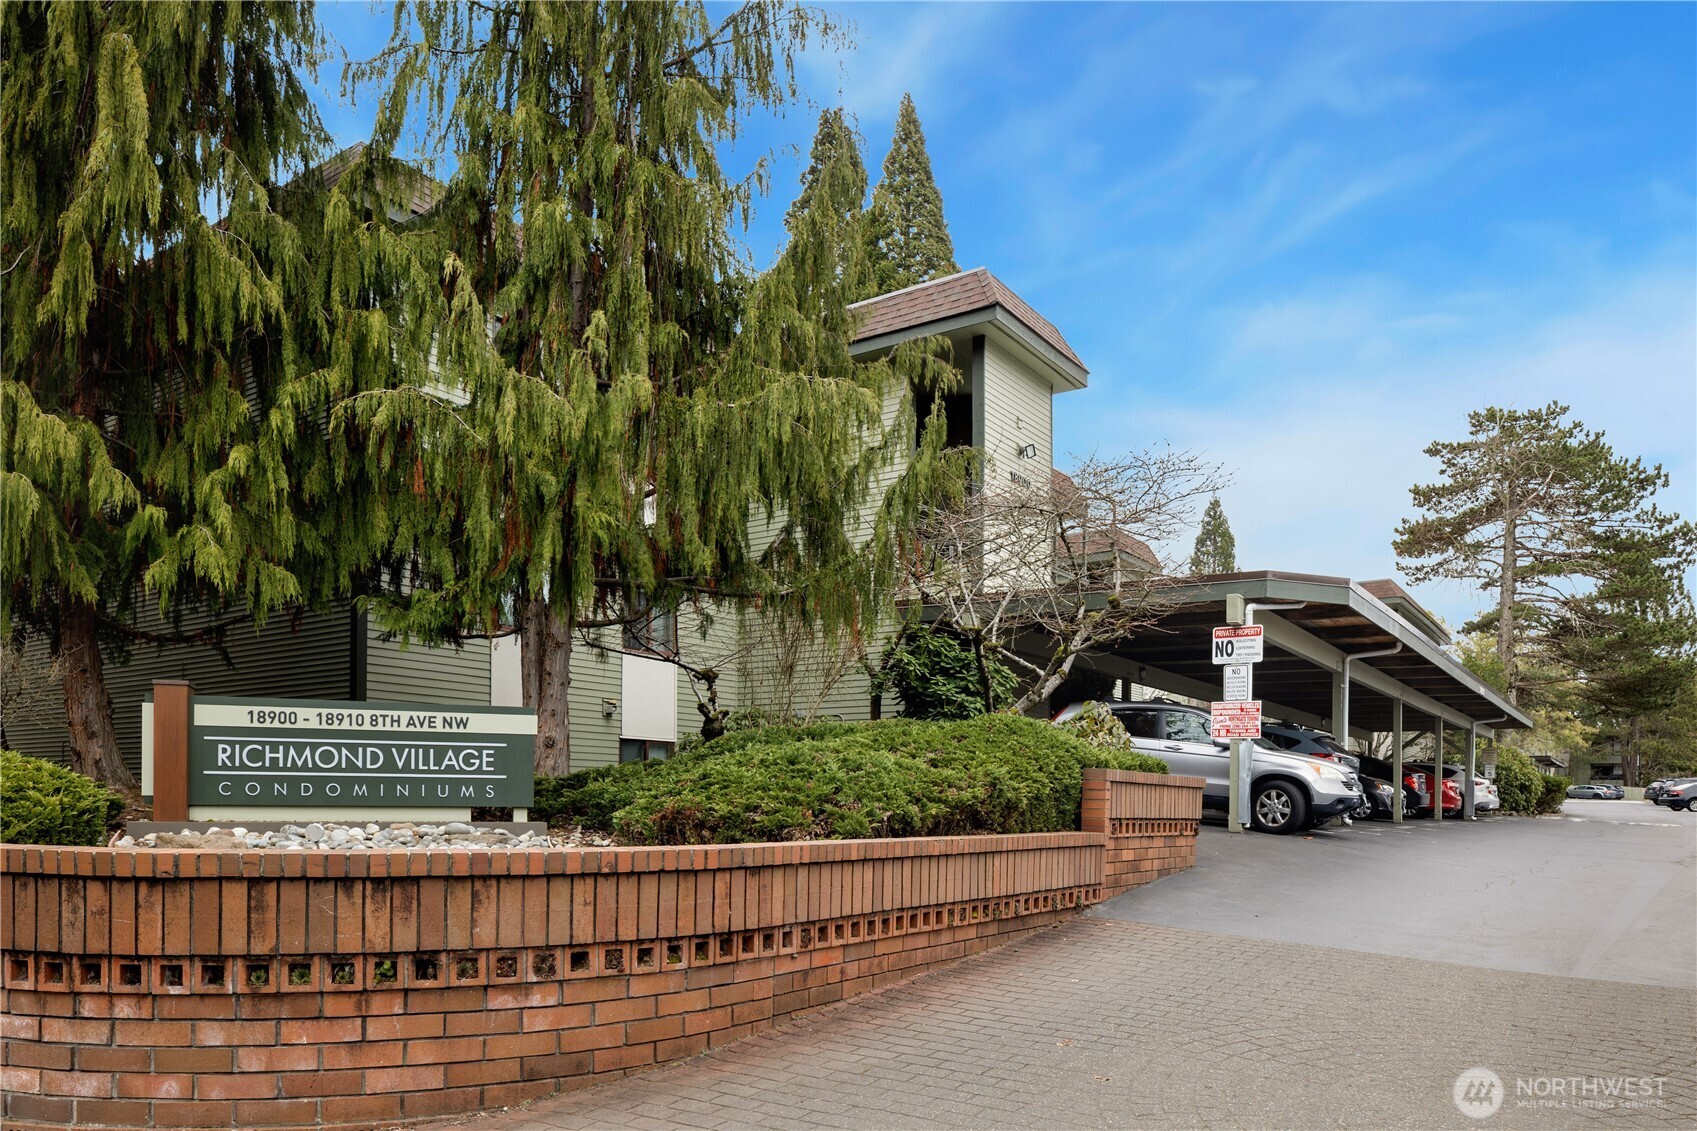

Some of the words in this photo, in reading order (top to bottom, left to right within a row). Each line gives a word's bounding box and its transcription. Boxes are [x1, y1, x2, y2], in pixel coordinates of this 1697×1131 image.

[1215, 629, 1235, 638] PRIVATE
[1235, 627, 1261, 636] PROPERTY
[1215, 640, 1235, 658] NO
[1231, 668, 1241, 676] NO
[247, 709, 298, 725] 18900
[315, 712, 365, 727] 18910
[369, 714, 401, 728] 8TH
[405, 715, 437, 729] AVE
[442, 716, 470, 730] NW
[217, 743, 384, 769] RICHMOND
[391, 748, 495, 772] VILLAGE
[218, 781, 495, 798] CONDOMINIUMS
